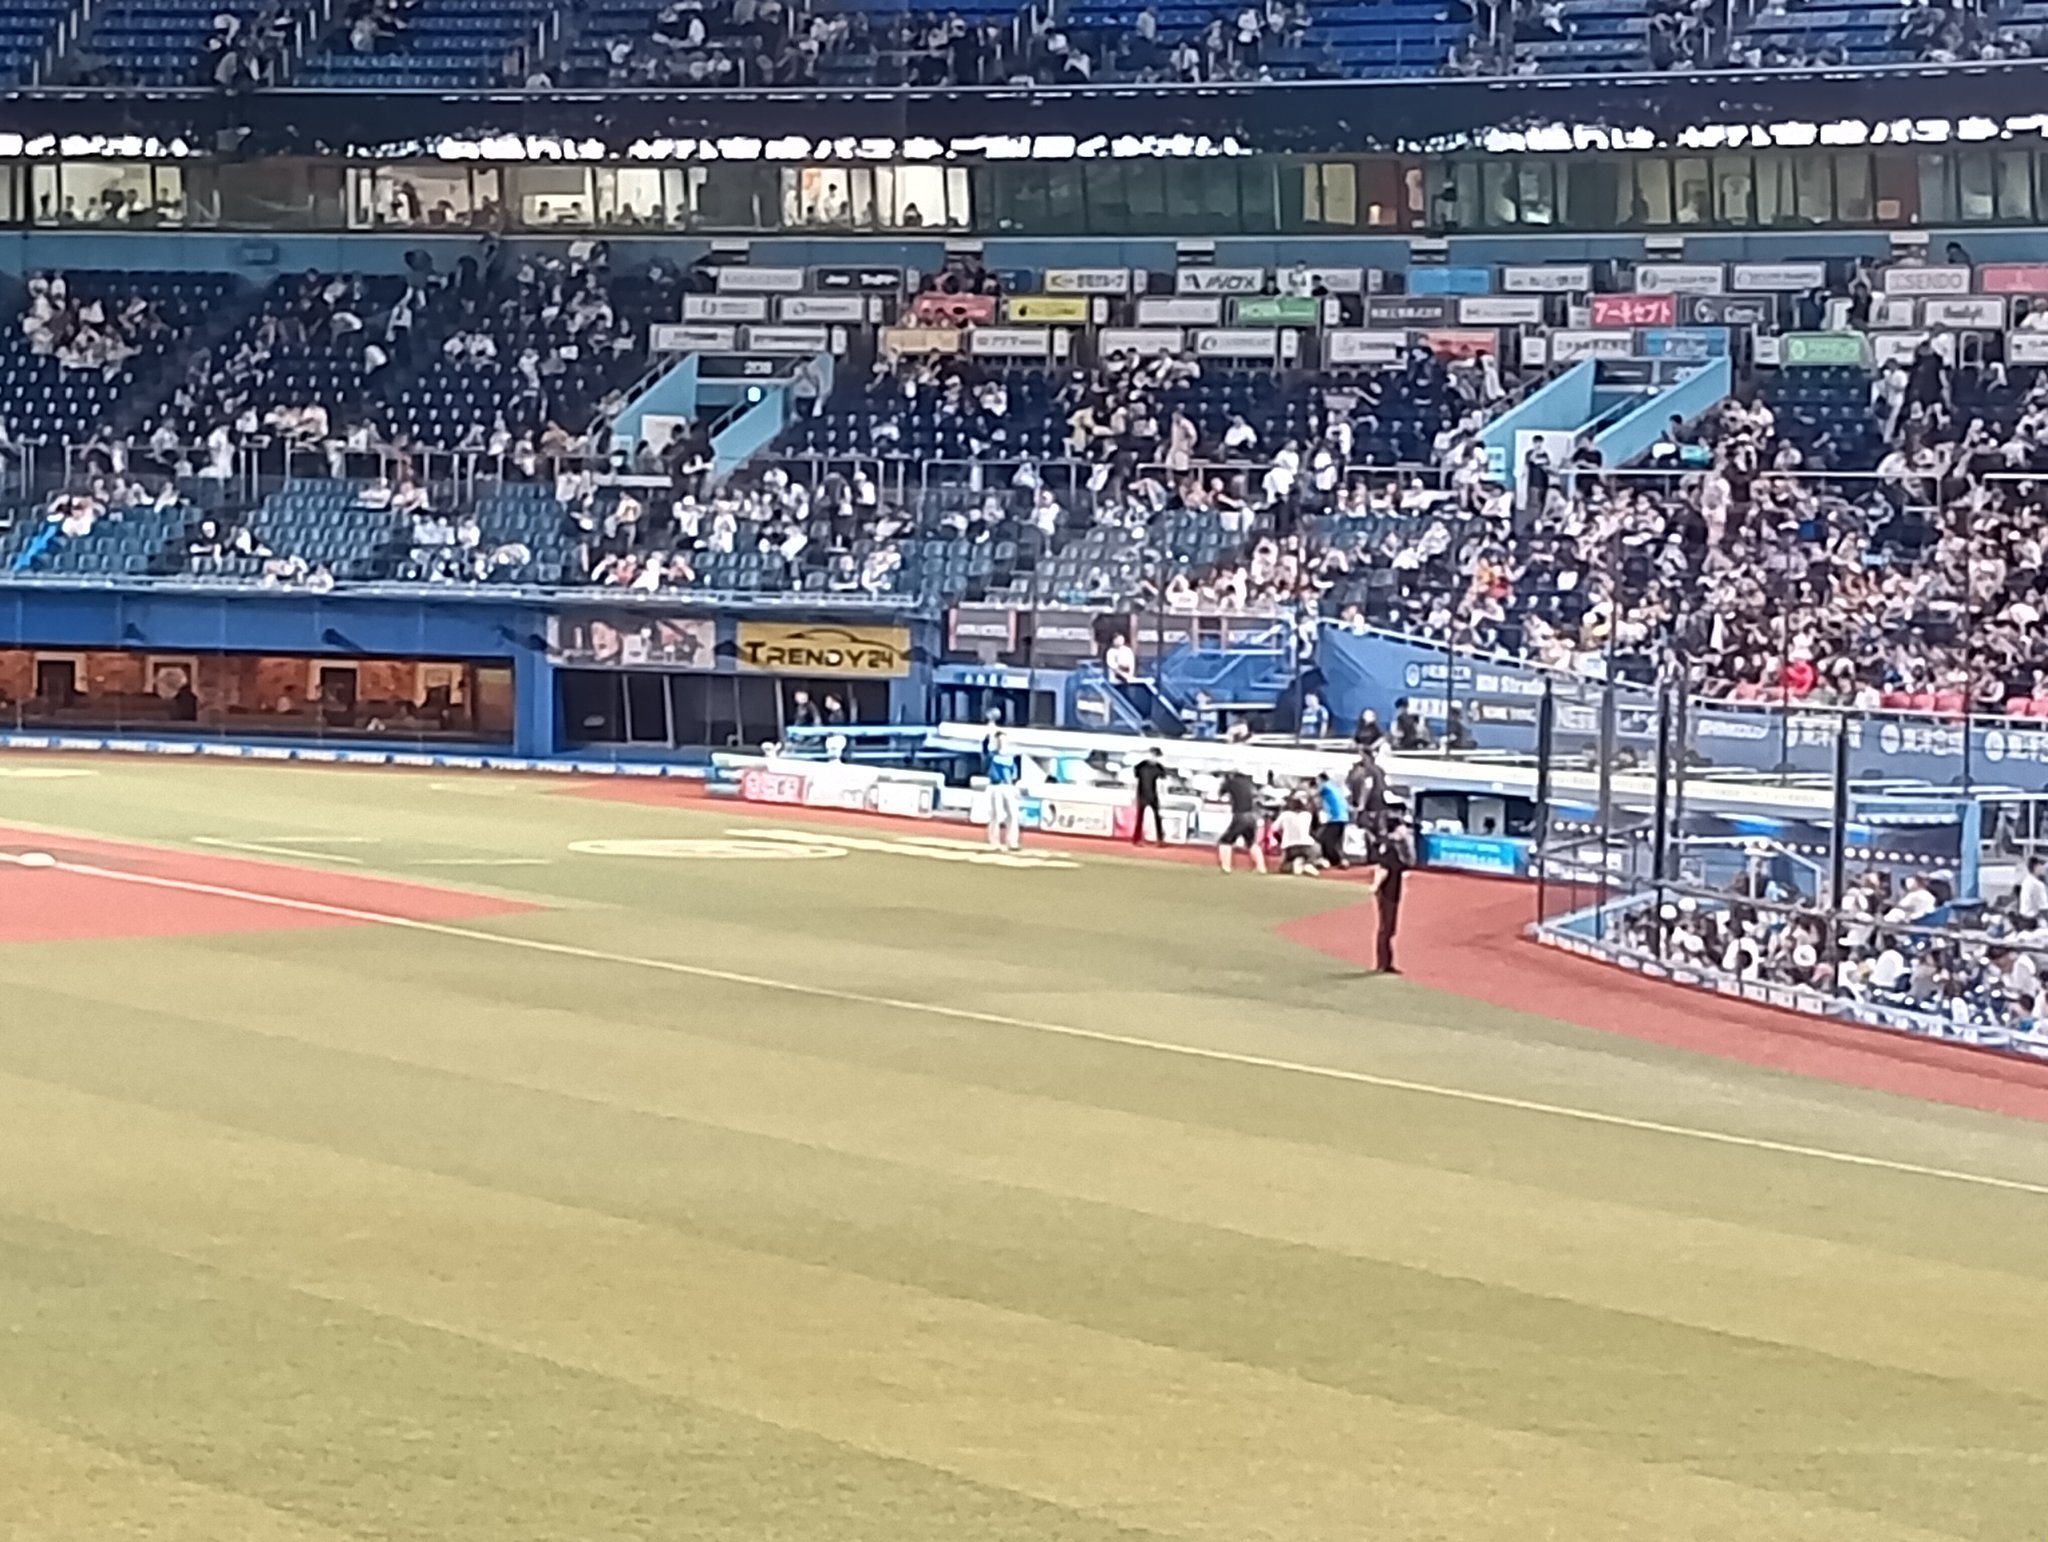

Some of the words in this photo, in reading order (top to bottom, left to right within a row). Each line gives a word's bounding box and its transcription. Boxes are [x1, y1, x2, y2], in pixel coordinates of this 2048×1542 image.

[1594, 301, 1671, 323] アーキセプト
[744, 641, 894, 668] TRENDY24
